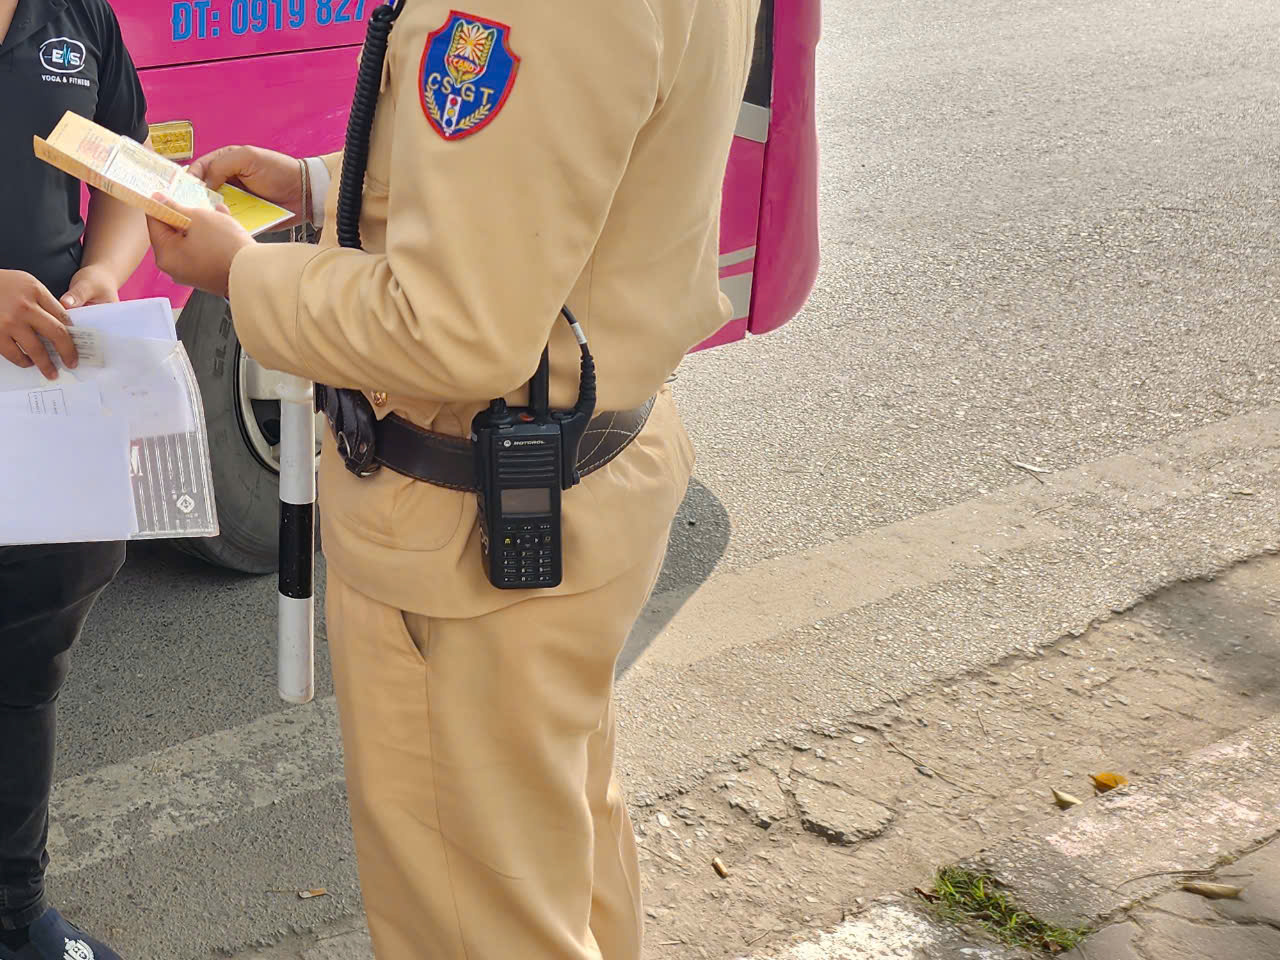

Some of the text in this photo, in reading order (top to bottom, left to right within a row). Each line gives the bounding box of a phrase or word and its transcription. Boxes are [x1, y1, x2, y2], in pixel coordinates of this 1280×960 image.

[171, 0, 220, 41] ĐT:
[41, 74, 61, 83] YOGA
[69, 77, 90, 87] FITNESS
